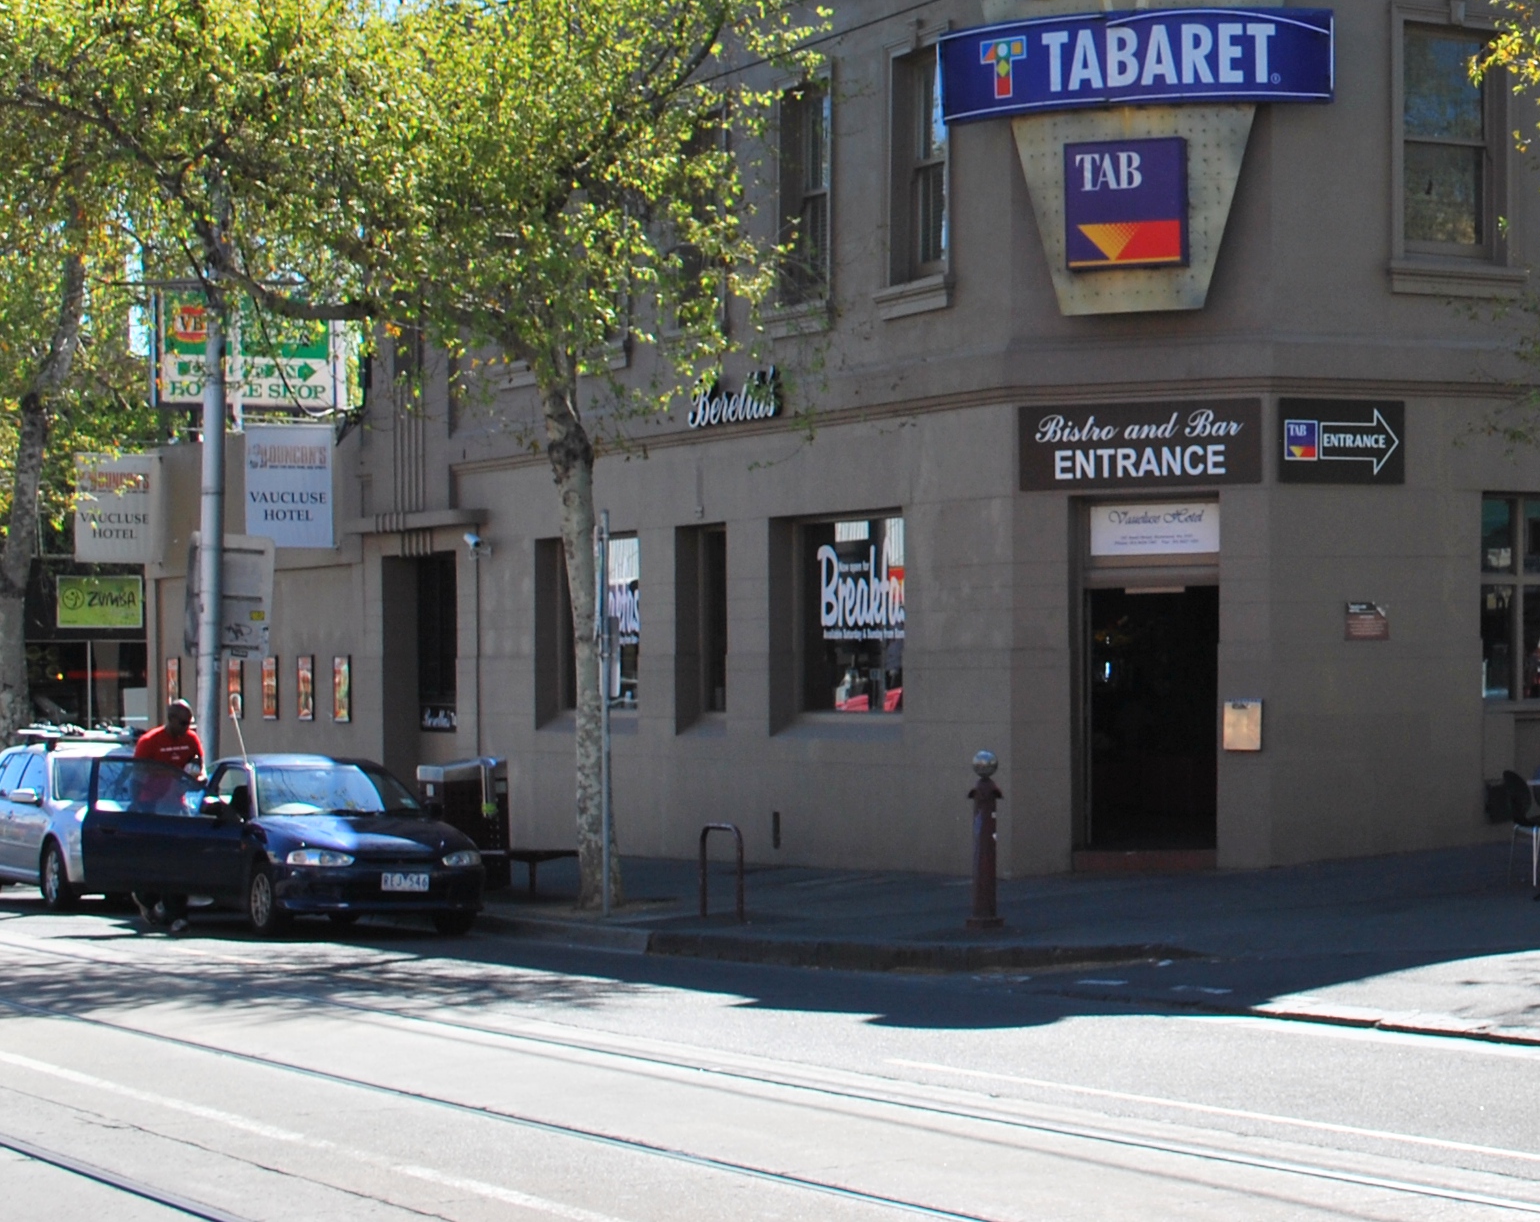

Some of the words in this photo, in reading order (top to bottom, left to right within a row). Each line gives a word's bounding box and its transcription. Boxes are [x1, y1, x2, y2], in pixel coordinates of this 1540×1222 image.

[1041, 23, 1276, 92] TABARET
[1075, 151, 1142, 191] TAB
[1035, 414, 1119, 443] Bistro
[1124, 412, 1180, 440] and
[1184, 408, 1244, 437] Bar
[1288, 424, 1307, 437] TAB
[1323, 433, 1386, 448] ENTRANCE
[1054, 444, 1226, 480] ENTRANCE
[249, 491, 327, 504] VAUCLUSE
[80, 512, 149, 525] VAUCLUSE
[263, 509, 313, 521] HOTEL
[92, 528, 138, 539] HOTEL
[87, 591, 137, 608] ZUMBA
